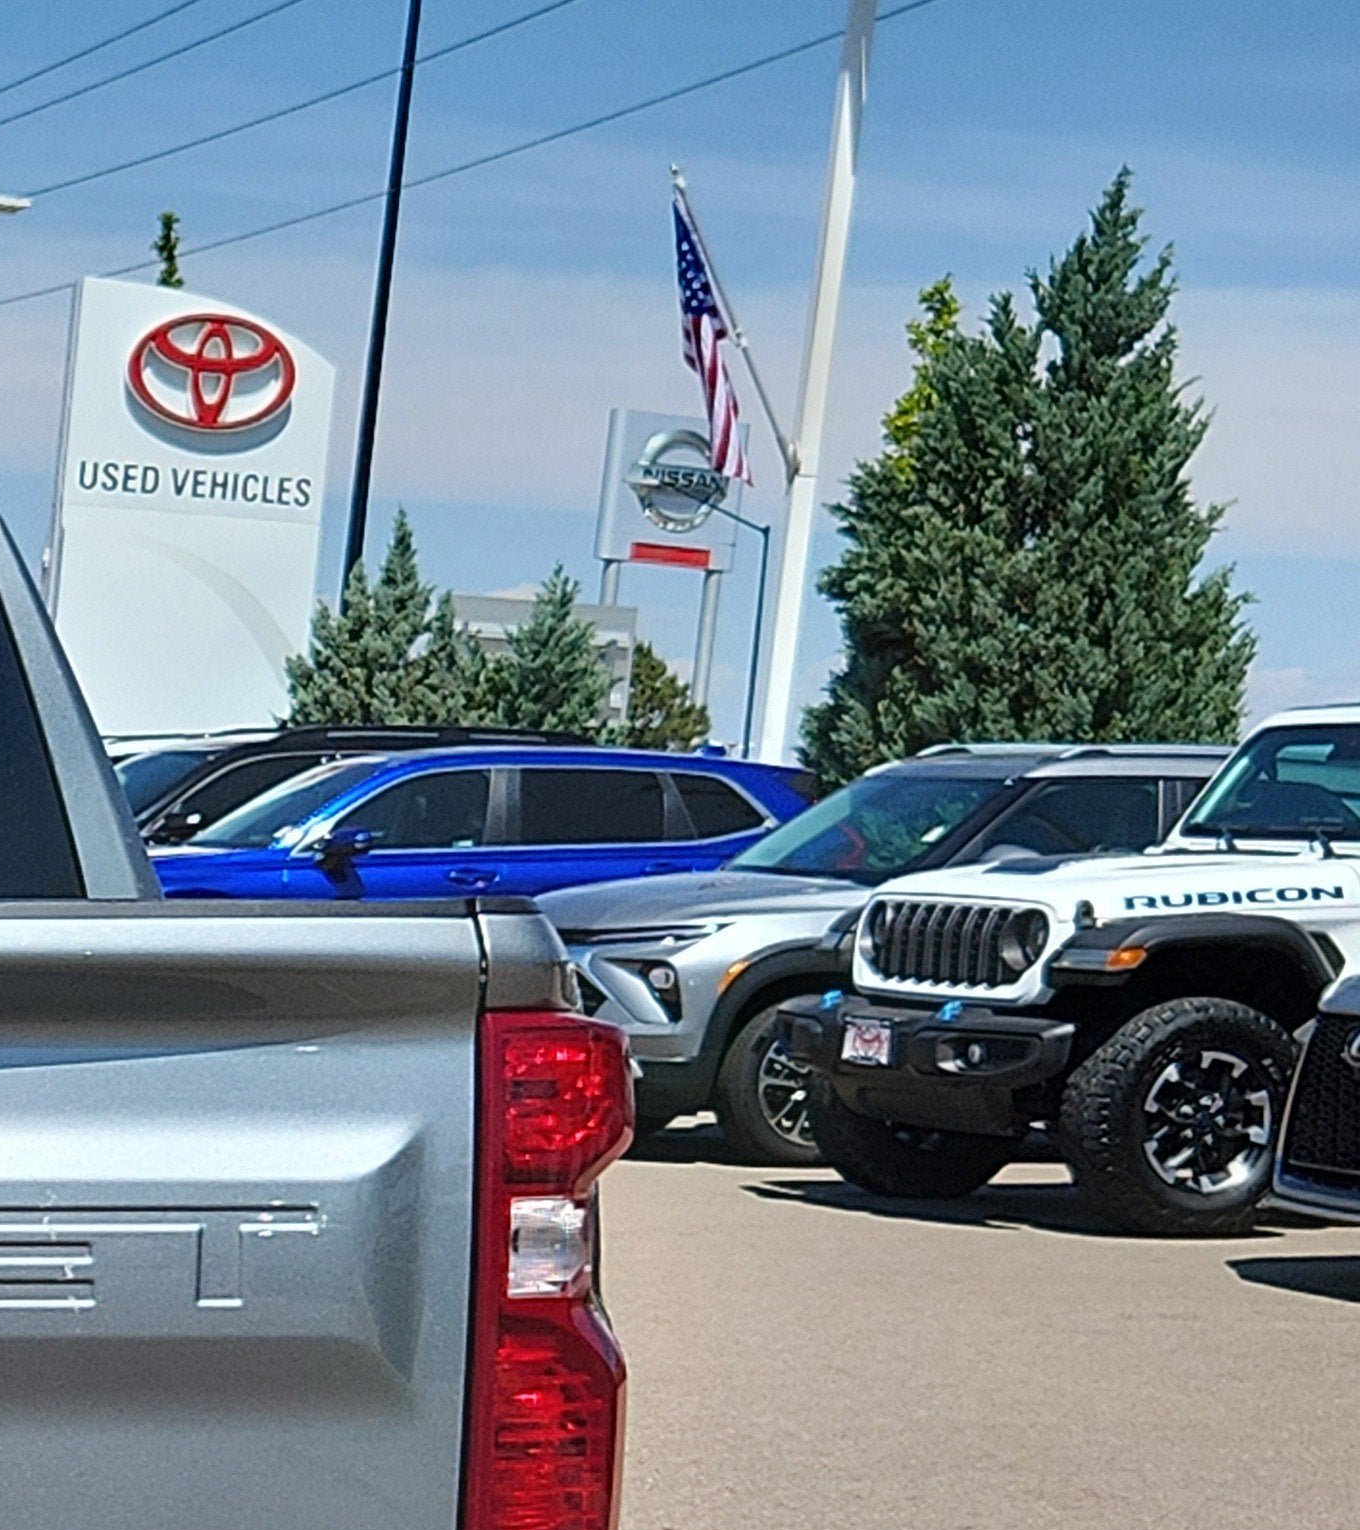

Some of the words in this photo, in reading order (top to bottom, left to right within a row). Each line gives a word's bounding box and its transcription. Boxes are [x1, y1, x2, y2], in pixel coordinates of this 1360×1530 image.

[79, 460, 159, 494] USED
[171, 467, 311, 507] VEHICLES
[643, 467, 727, 496] NISSAN
[1123, 886, 1344, 910] RUBICON
